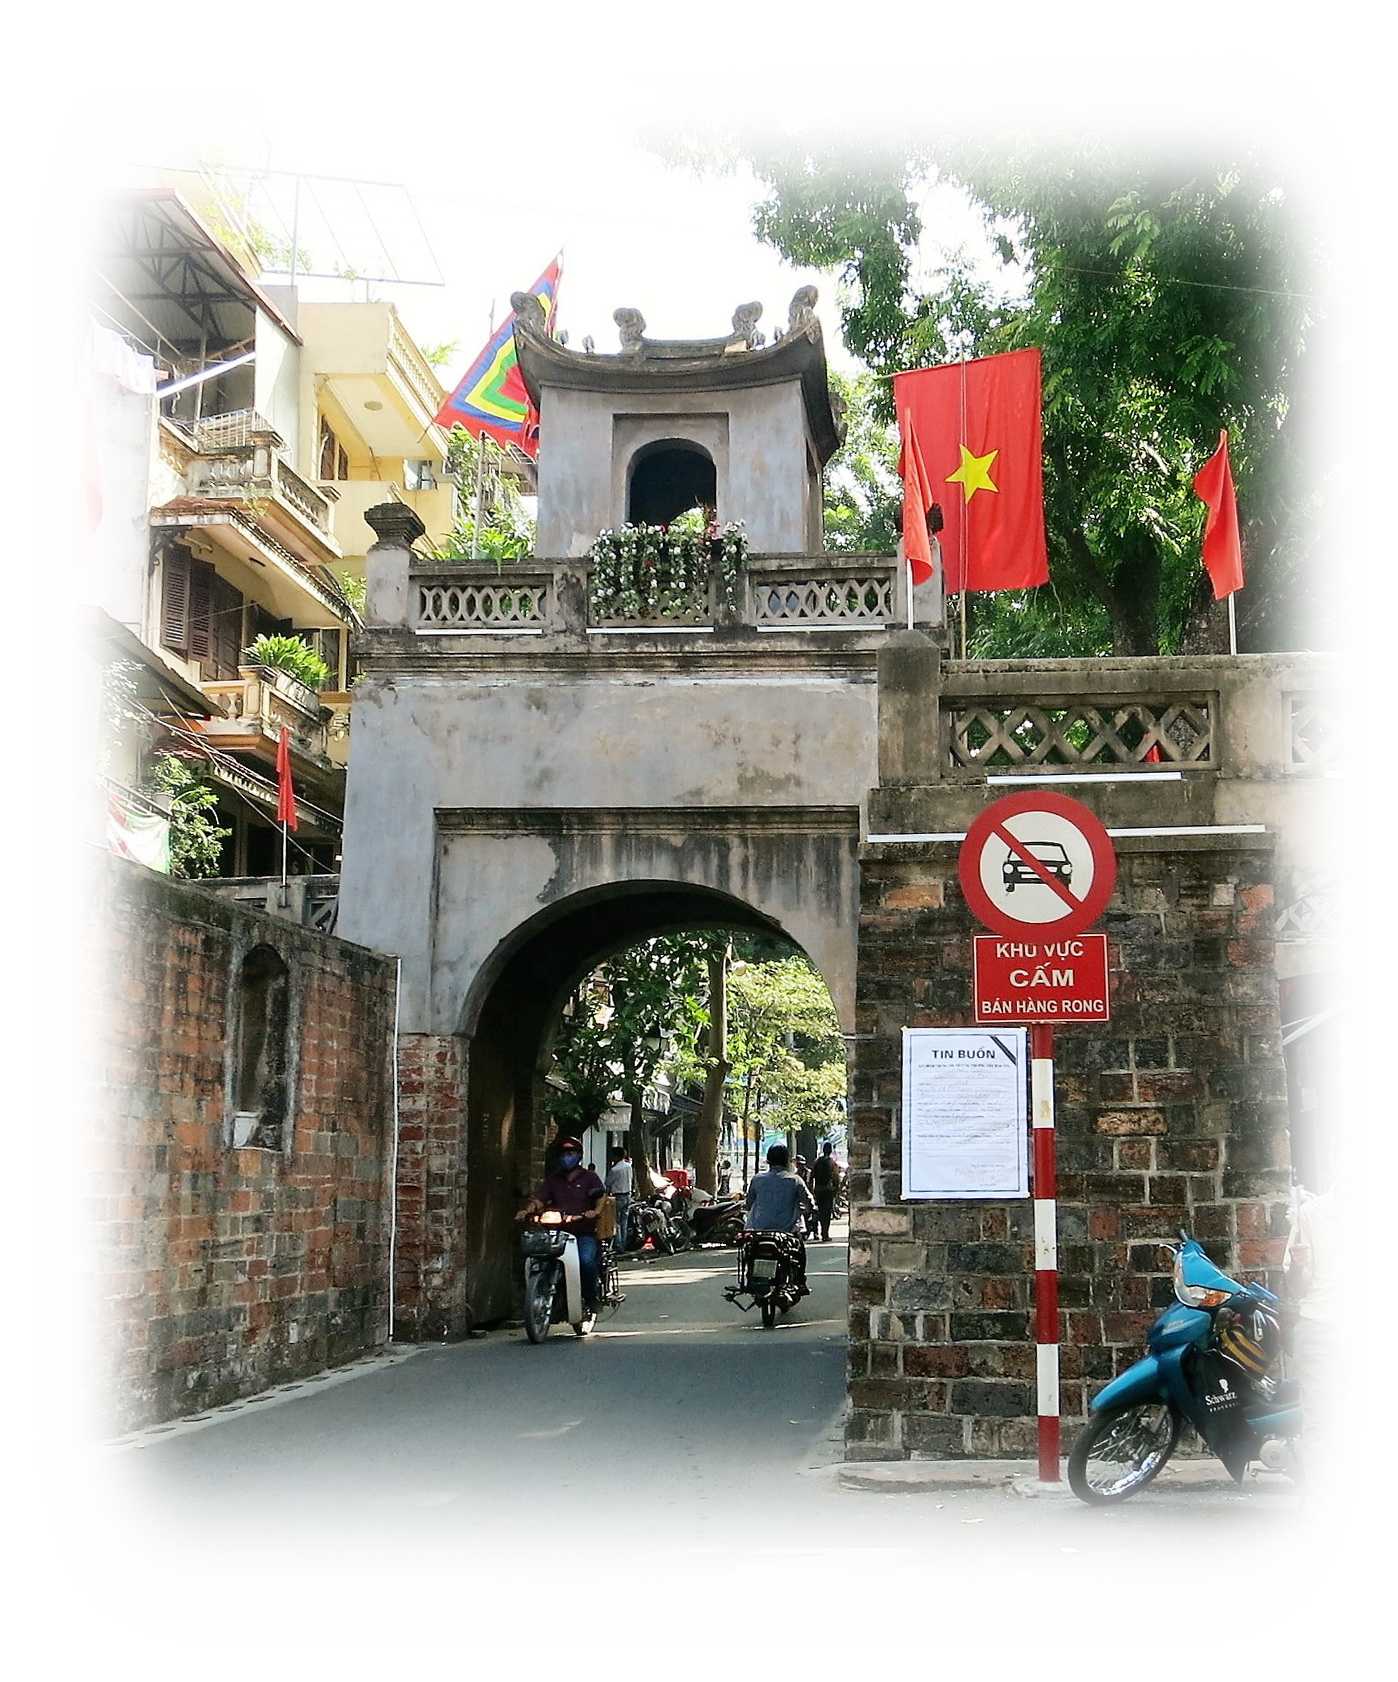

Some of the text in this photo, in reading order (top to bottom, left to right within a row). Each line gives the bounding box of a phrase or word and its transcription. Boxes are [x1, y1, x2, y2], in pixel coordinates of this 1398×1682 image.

[996, 940, 1084, 961] KHU VỰC
[1009, 961, 1074, 987] CẤM
[981, 996, 1104, 1014] BÁN HÀNG RONG
[931, 1049, 954, 1059] TIN
